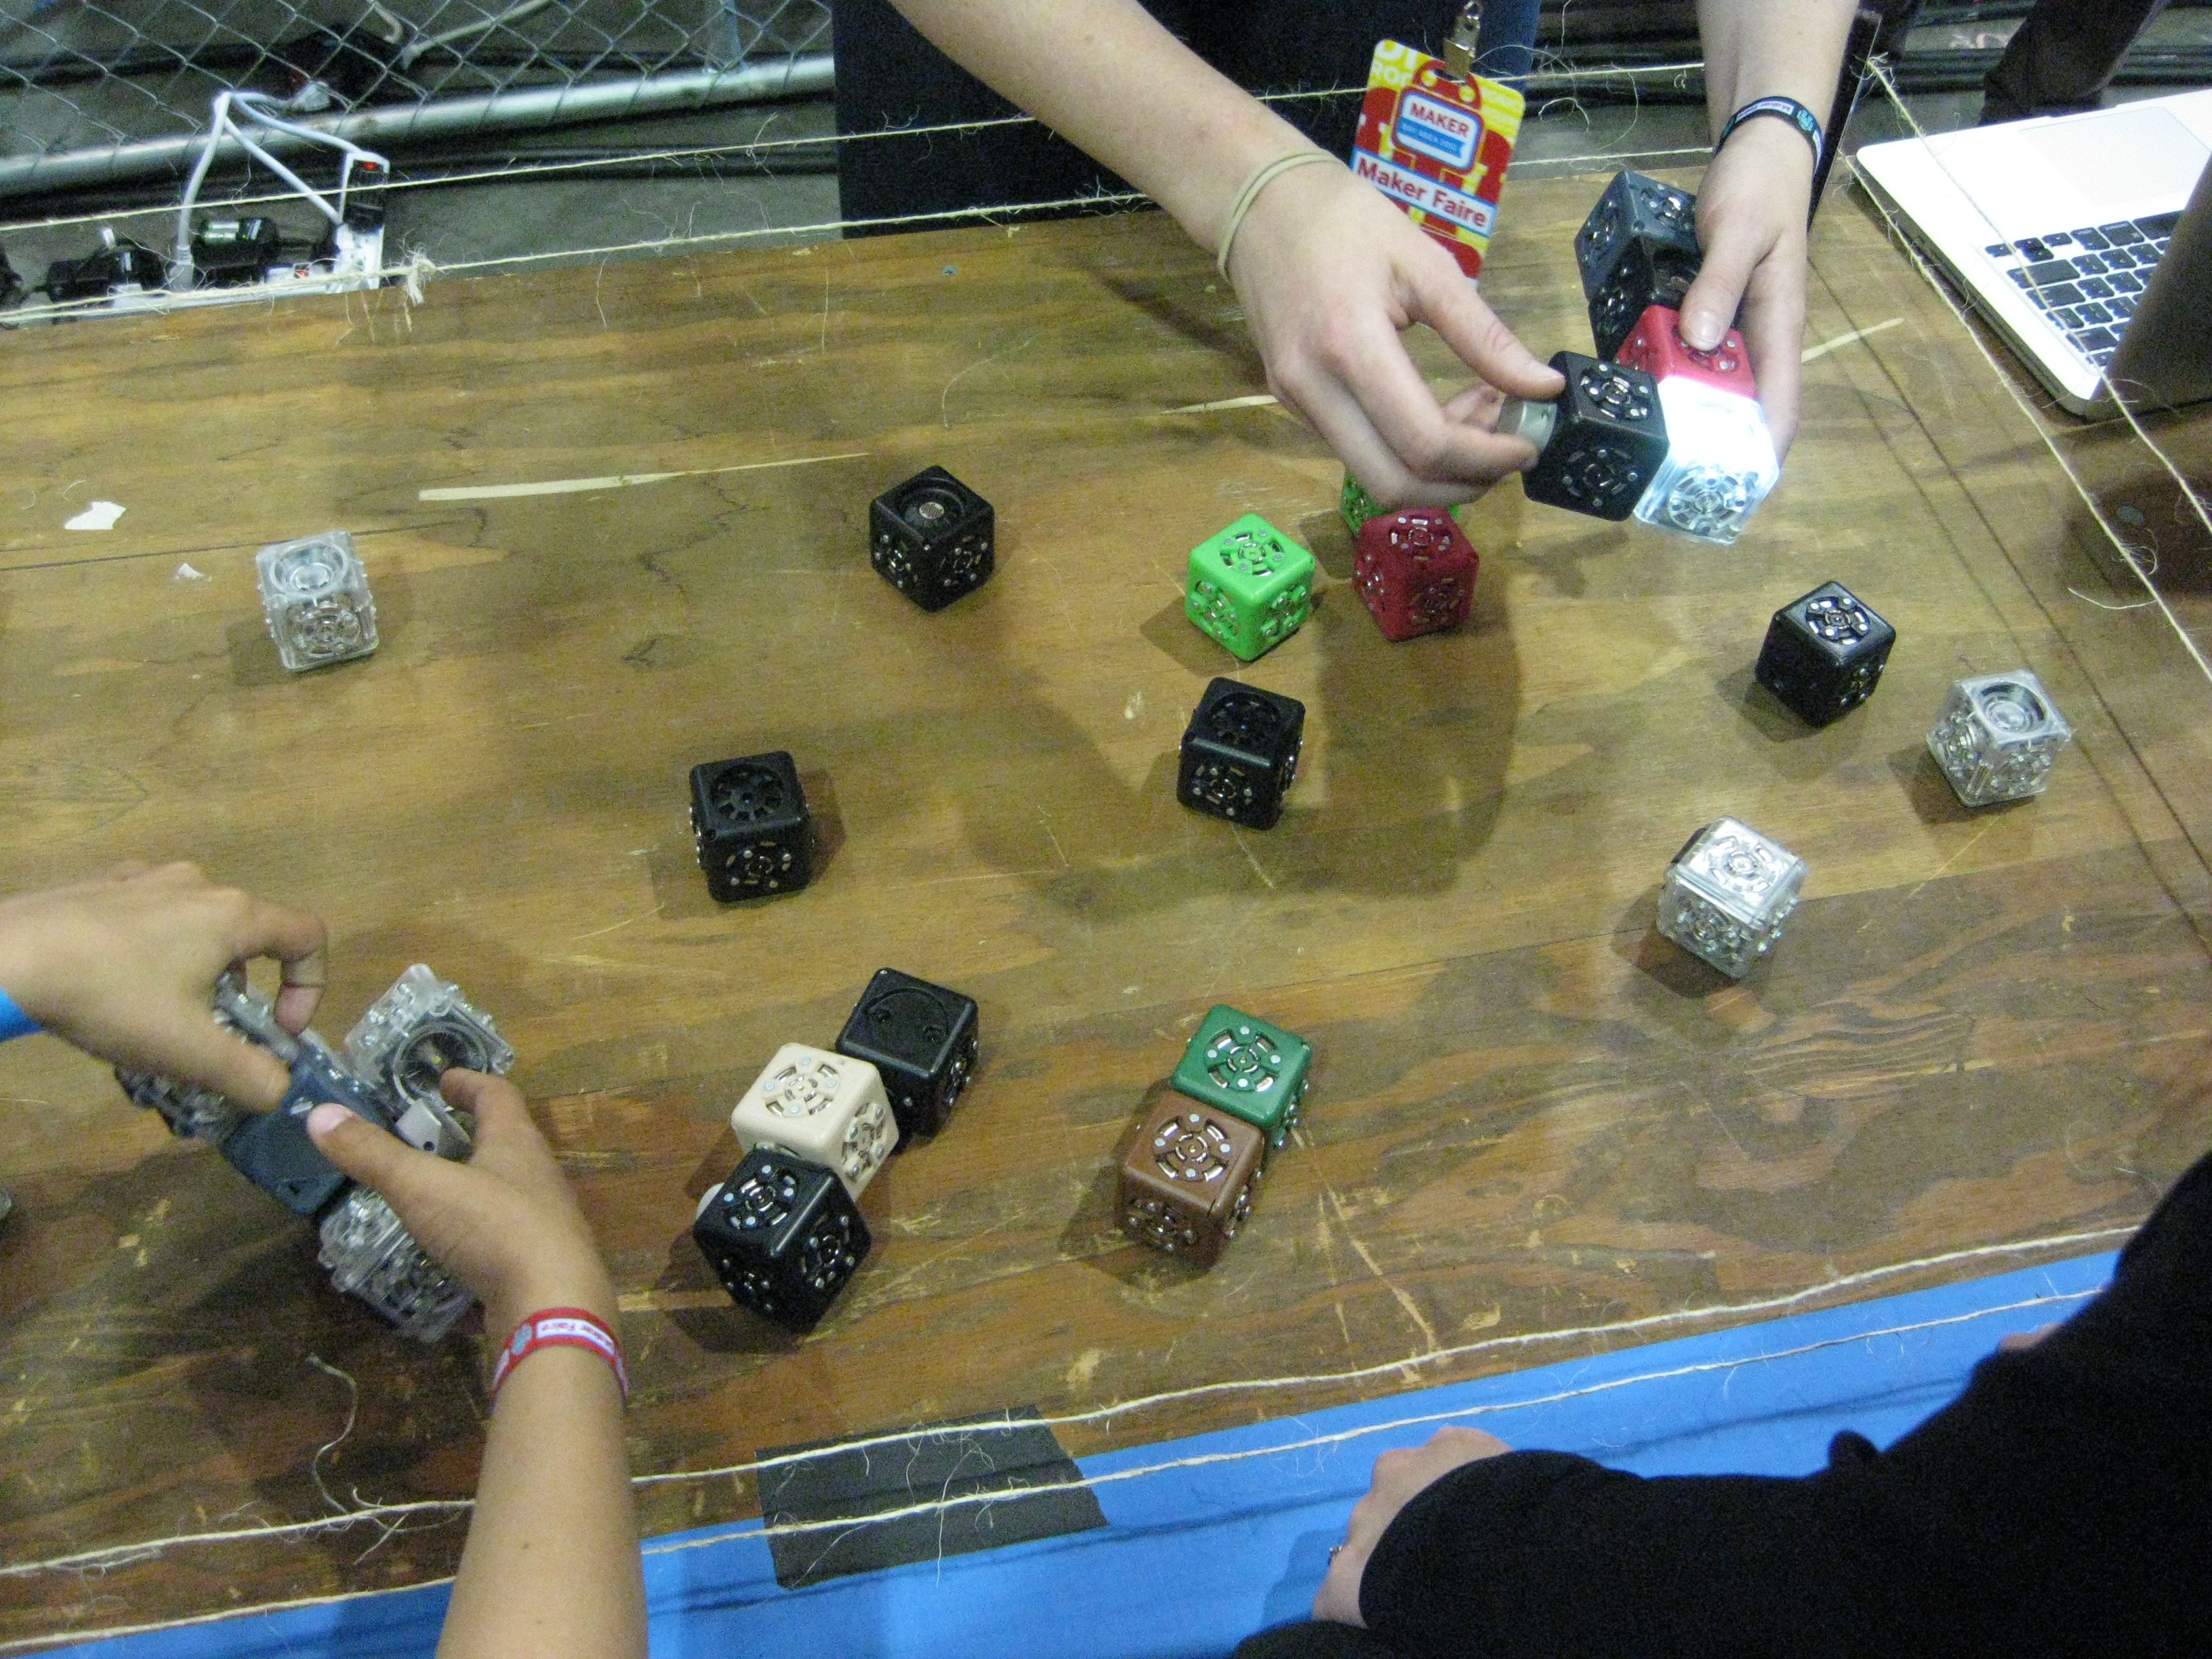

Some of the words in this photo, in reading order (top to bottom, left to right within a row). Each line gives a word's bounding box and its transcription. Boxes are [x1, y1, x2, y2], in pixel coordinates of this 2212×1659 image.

[1411, 103, 1469, 138] MAKER
[1357, 157, 1427, 201] Maker
[1432, 189, 1487, 227] Faire
